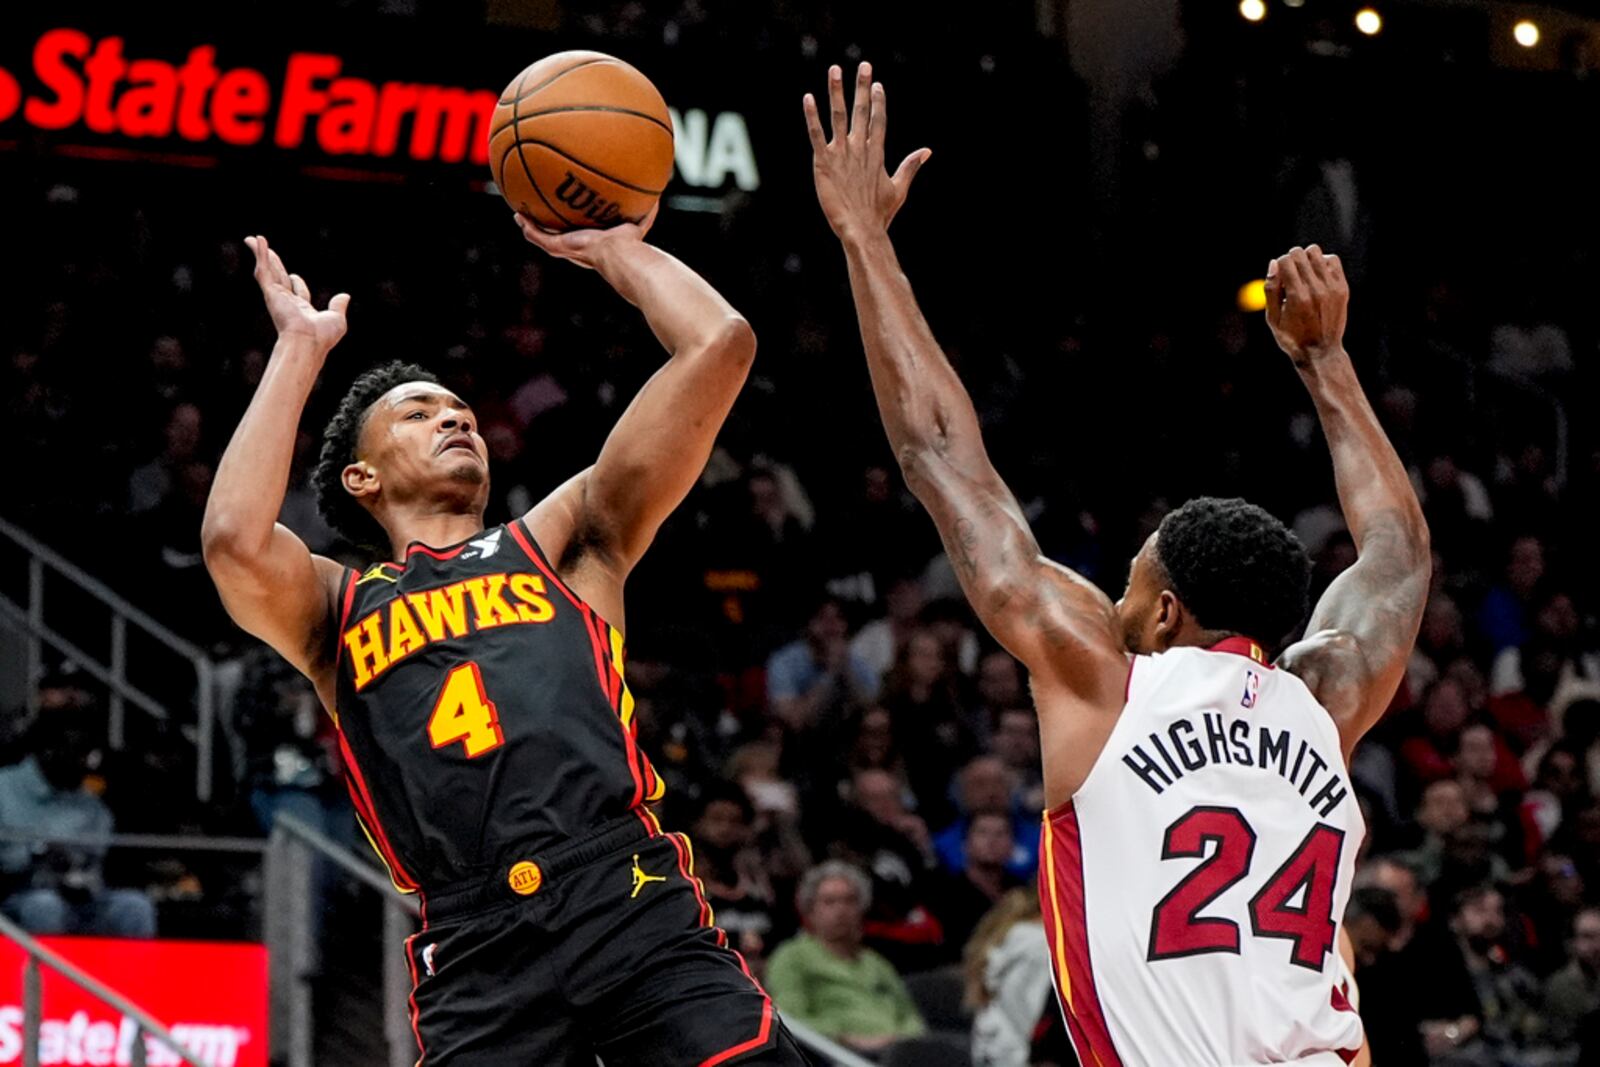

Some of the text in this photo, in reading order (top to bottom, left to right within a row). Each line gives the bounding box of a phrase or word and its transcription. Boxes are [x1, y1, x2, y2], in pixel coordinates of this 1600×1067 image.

[24, 27, 760, 191] State Farm NA
[555, 170, 622, 224] Wil
[343, 572, 556, 692] HAWKS
[427, 660, 505, 759] 4
[1121, 713, 1348, 818] HIGHSMITH
[513, 868, 538, 888] ATL
[1146, 805, 1346, 973] 24
[0, 1005, 116, 1066] Sate
